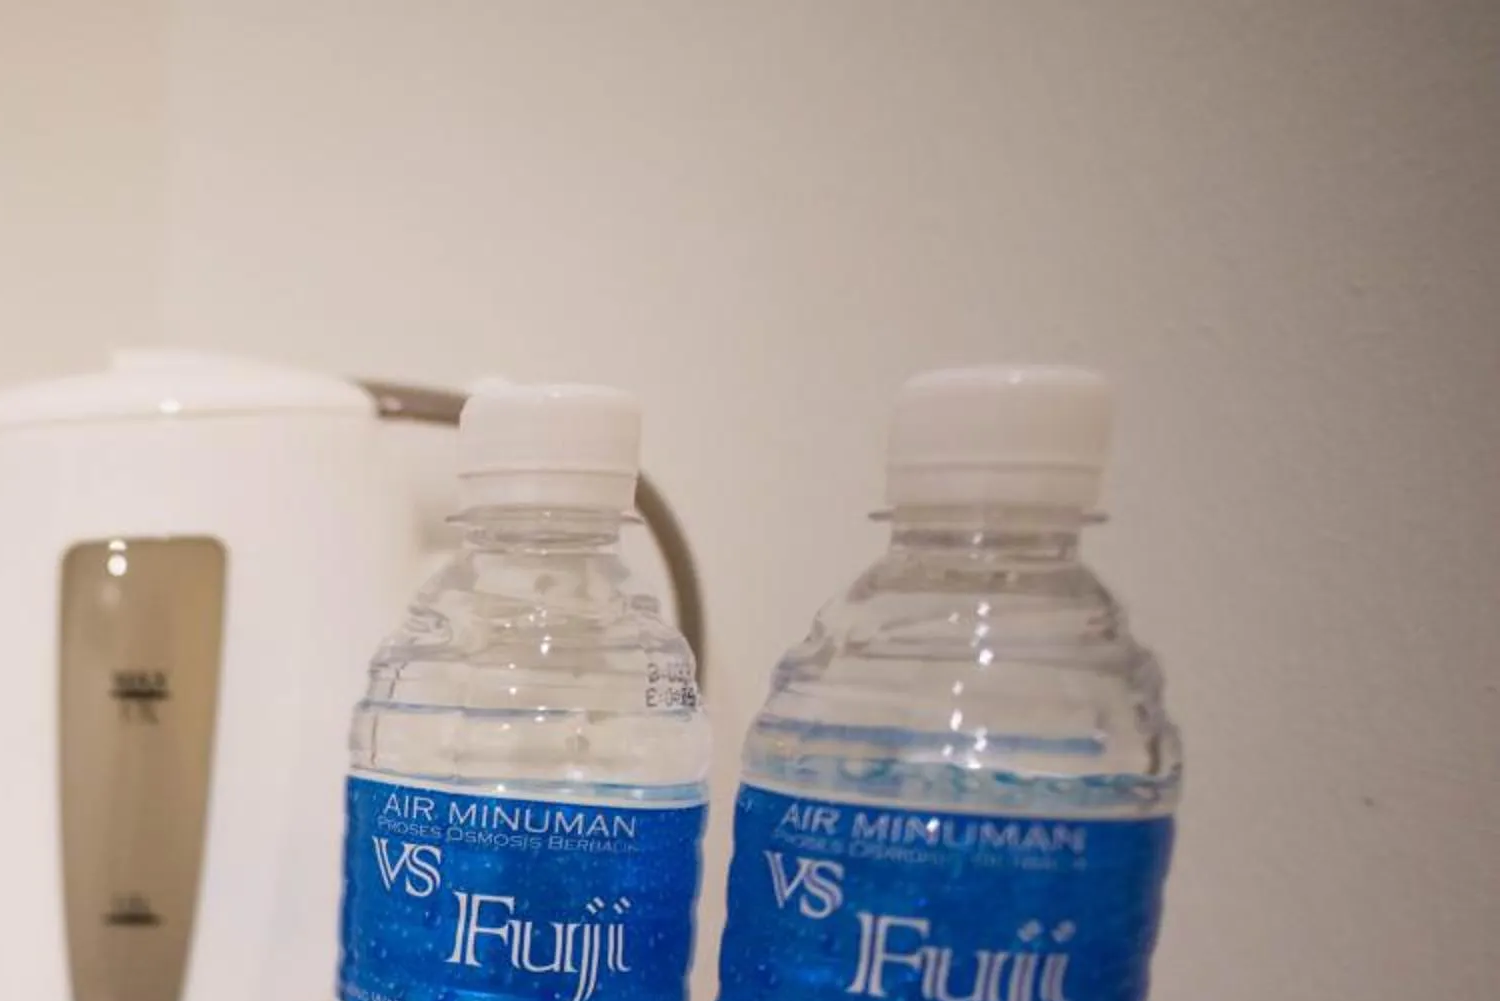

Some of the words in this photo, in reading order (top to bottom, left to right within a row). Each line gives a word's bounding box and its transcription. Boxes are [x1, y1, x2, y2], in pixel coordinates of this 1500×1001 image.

[383, 793, 435, 822] AIR
[449, 800, 636, 839] MINUMAN
[448, 826, 542, 852] OSMOSIS
[776, 803, 842, 836] AIR
[852, 811, 1087, 854] MINUMAN
[372, 836, 442, 897] VS
[763, 849, 846, 920] VS
